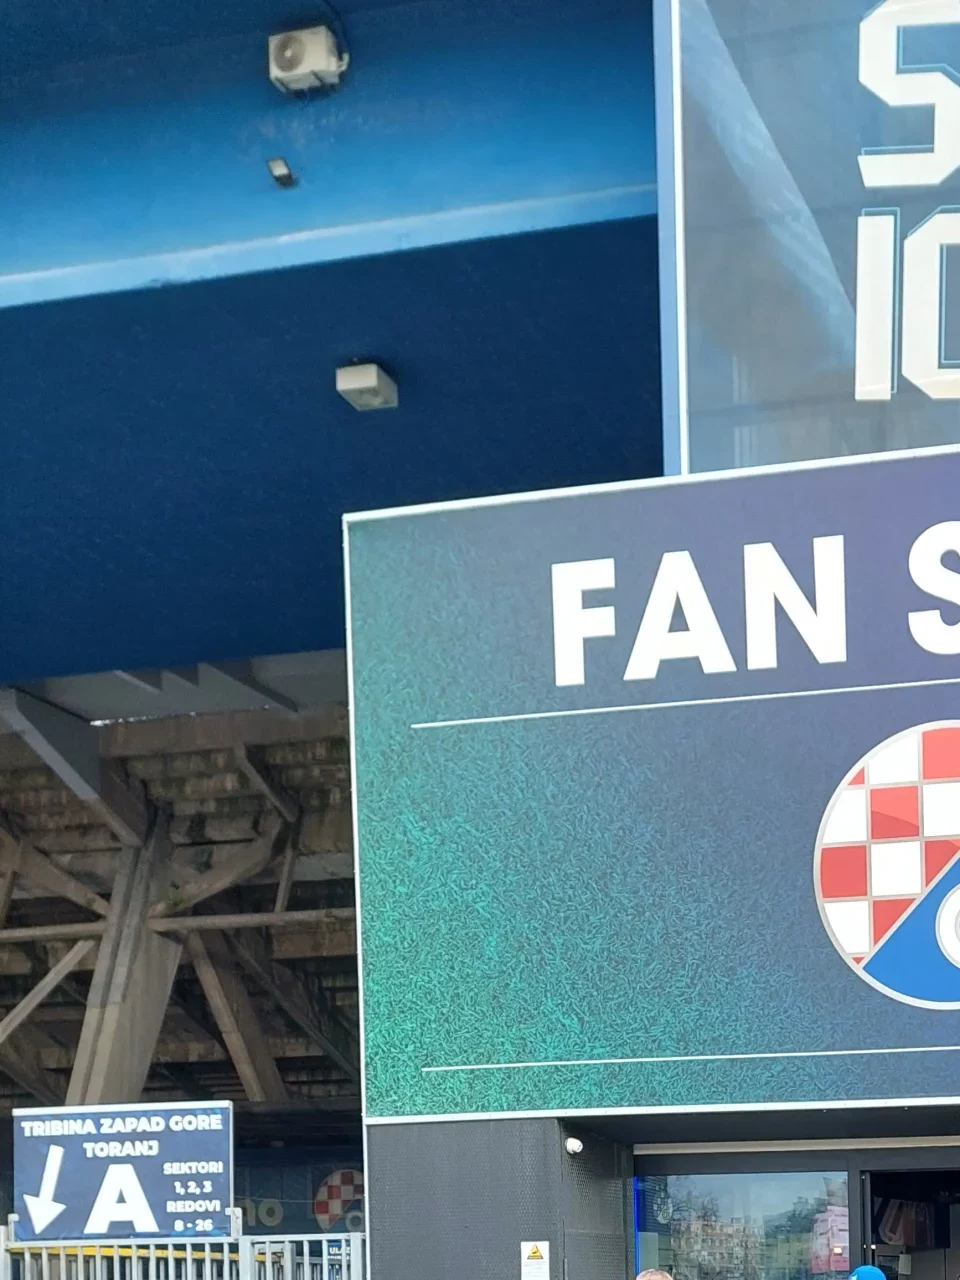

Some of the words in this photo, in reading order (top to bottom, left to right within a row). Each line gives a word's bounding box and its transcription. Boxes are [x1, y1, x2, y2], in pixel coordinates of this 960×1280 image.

[550, 533, 848, 687] FAN
[21, 1118, 97, 1137] TRIBINA
[100, 1115, 165, 1133] ZAPAD
[169, 1114, 223, 1131] GORE
[83, 1140, 159, 1158] TORANJ
[163, 1161, 223, 1175] SEKTORI
[83, 1163, 160, 1234] A
[166, 1200, 221, 1213] REDOVI
